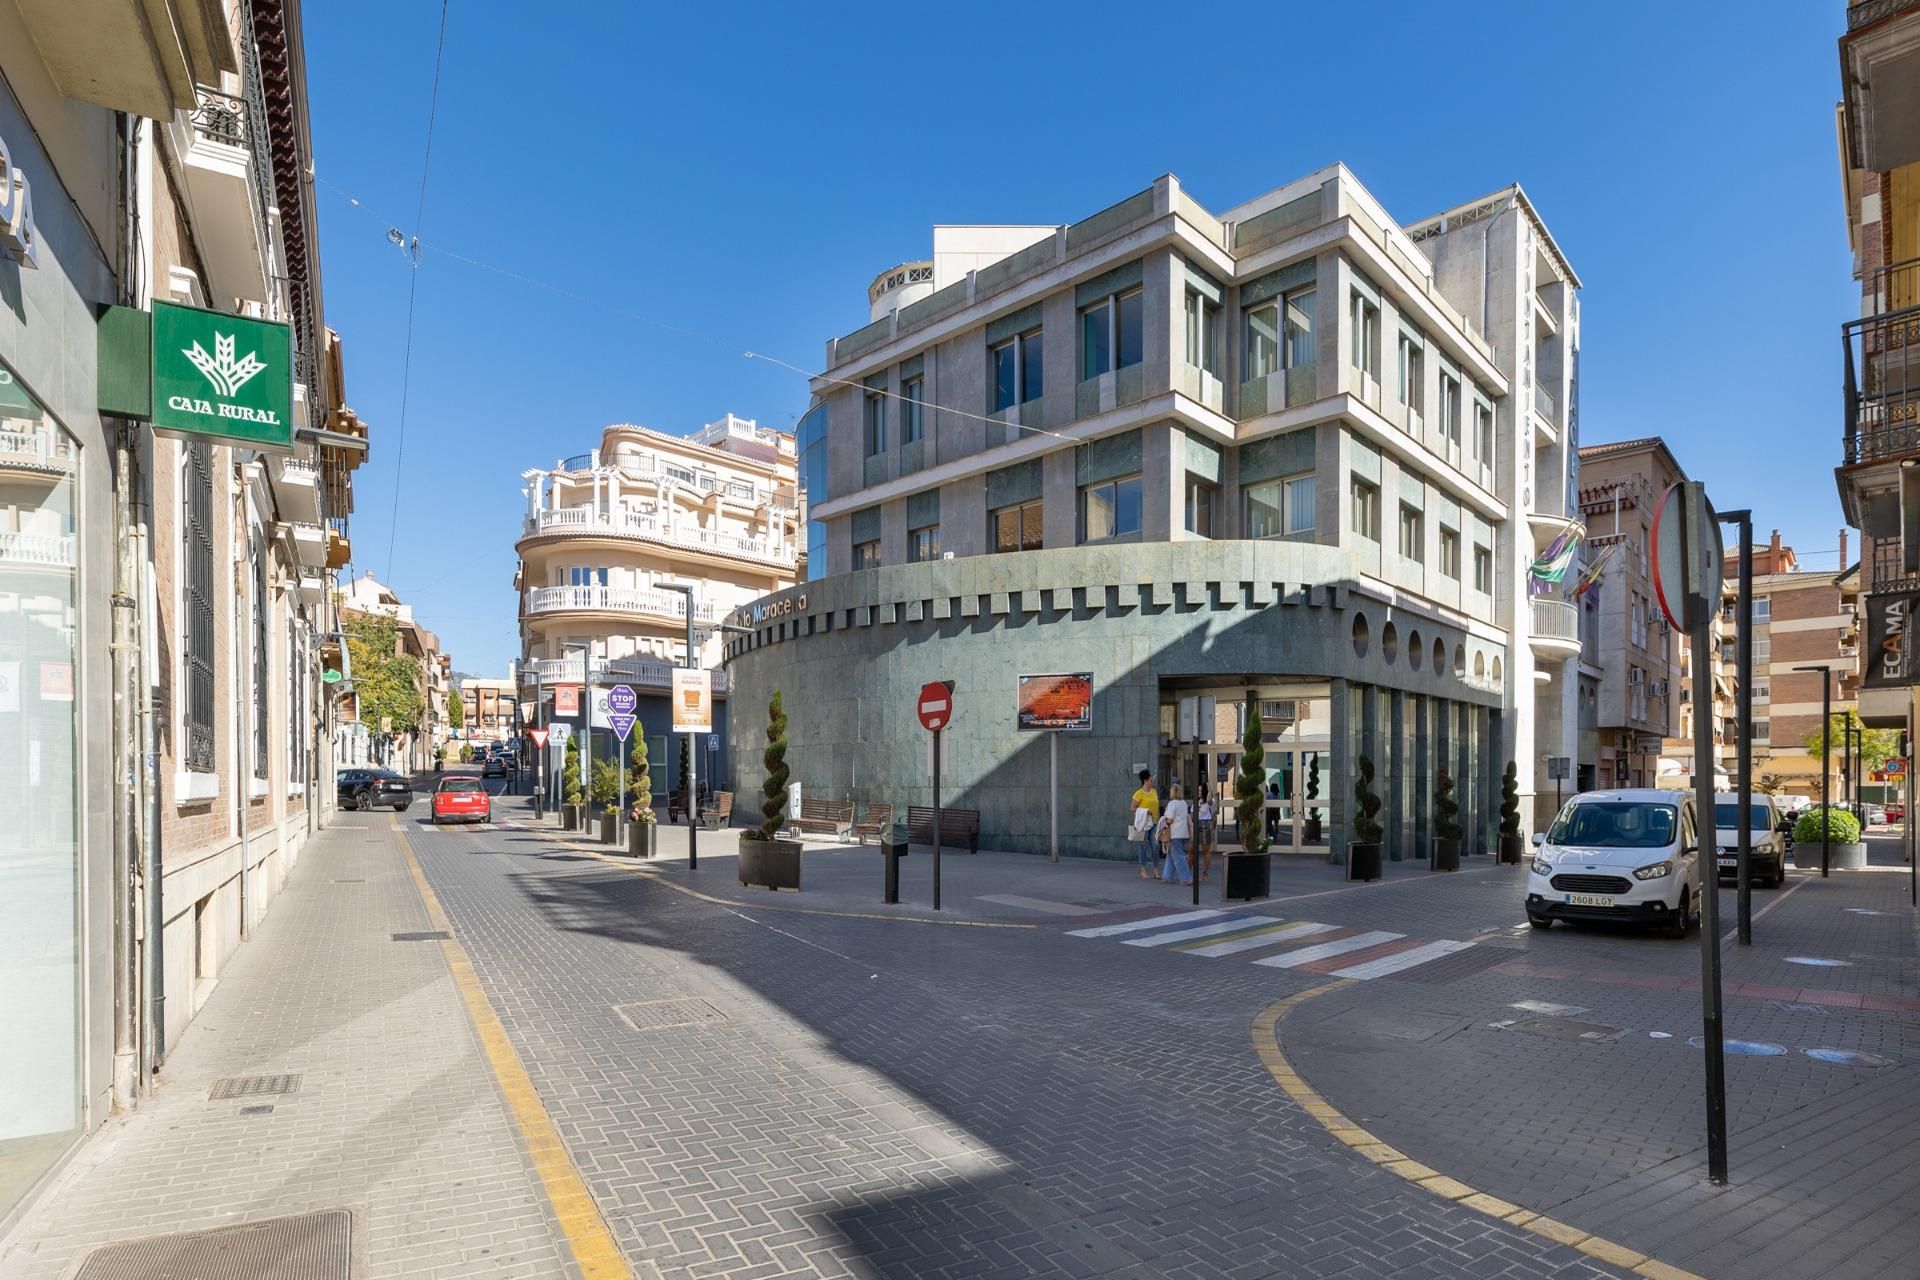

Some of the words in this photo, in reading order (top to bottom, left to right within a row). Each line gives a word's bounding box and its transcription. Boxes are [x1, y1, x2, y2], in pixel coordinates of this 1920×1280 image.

[168, 396, 214, 414] CAJA
[217, 403, 280, 425] RURAL
[753, 594, 807, 624] Maracea
[1883, 600, 1903, 678] ECAMA
[1572, 895, 1593, 904] 2608
[1595, 897, 1612, 905] LGY
